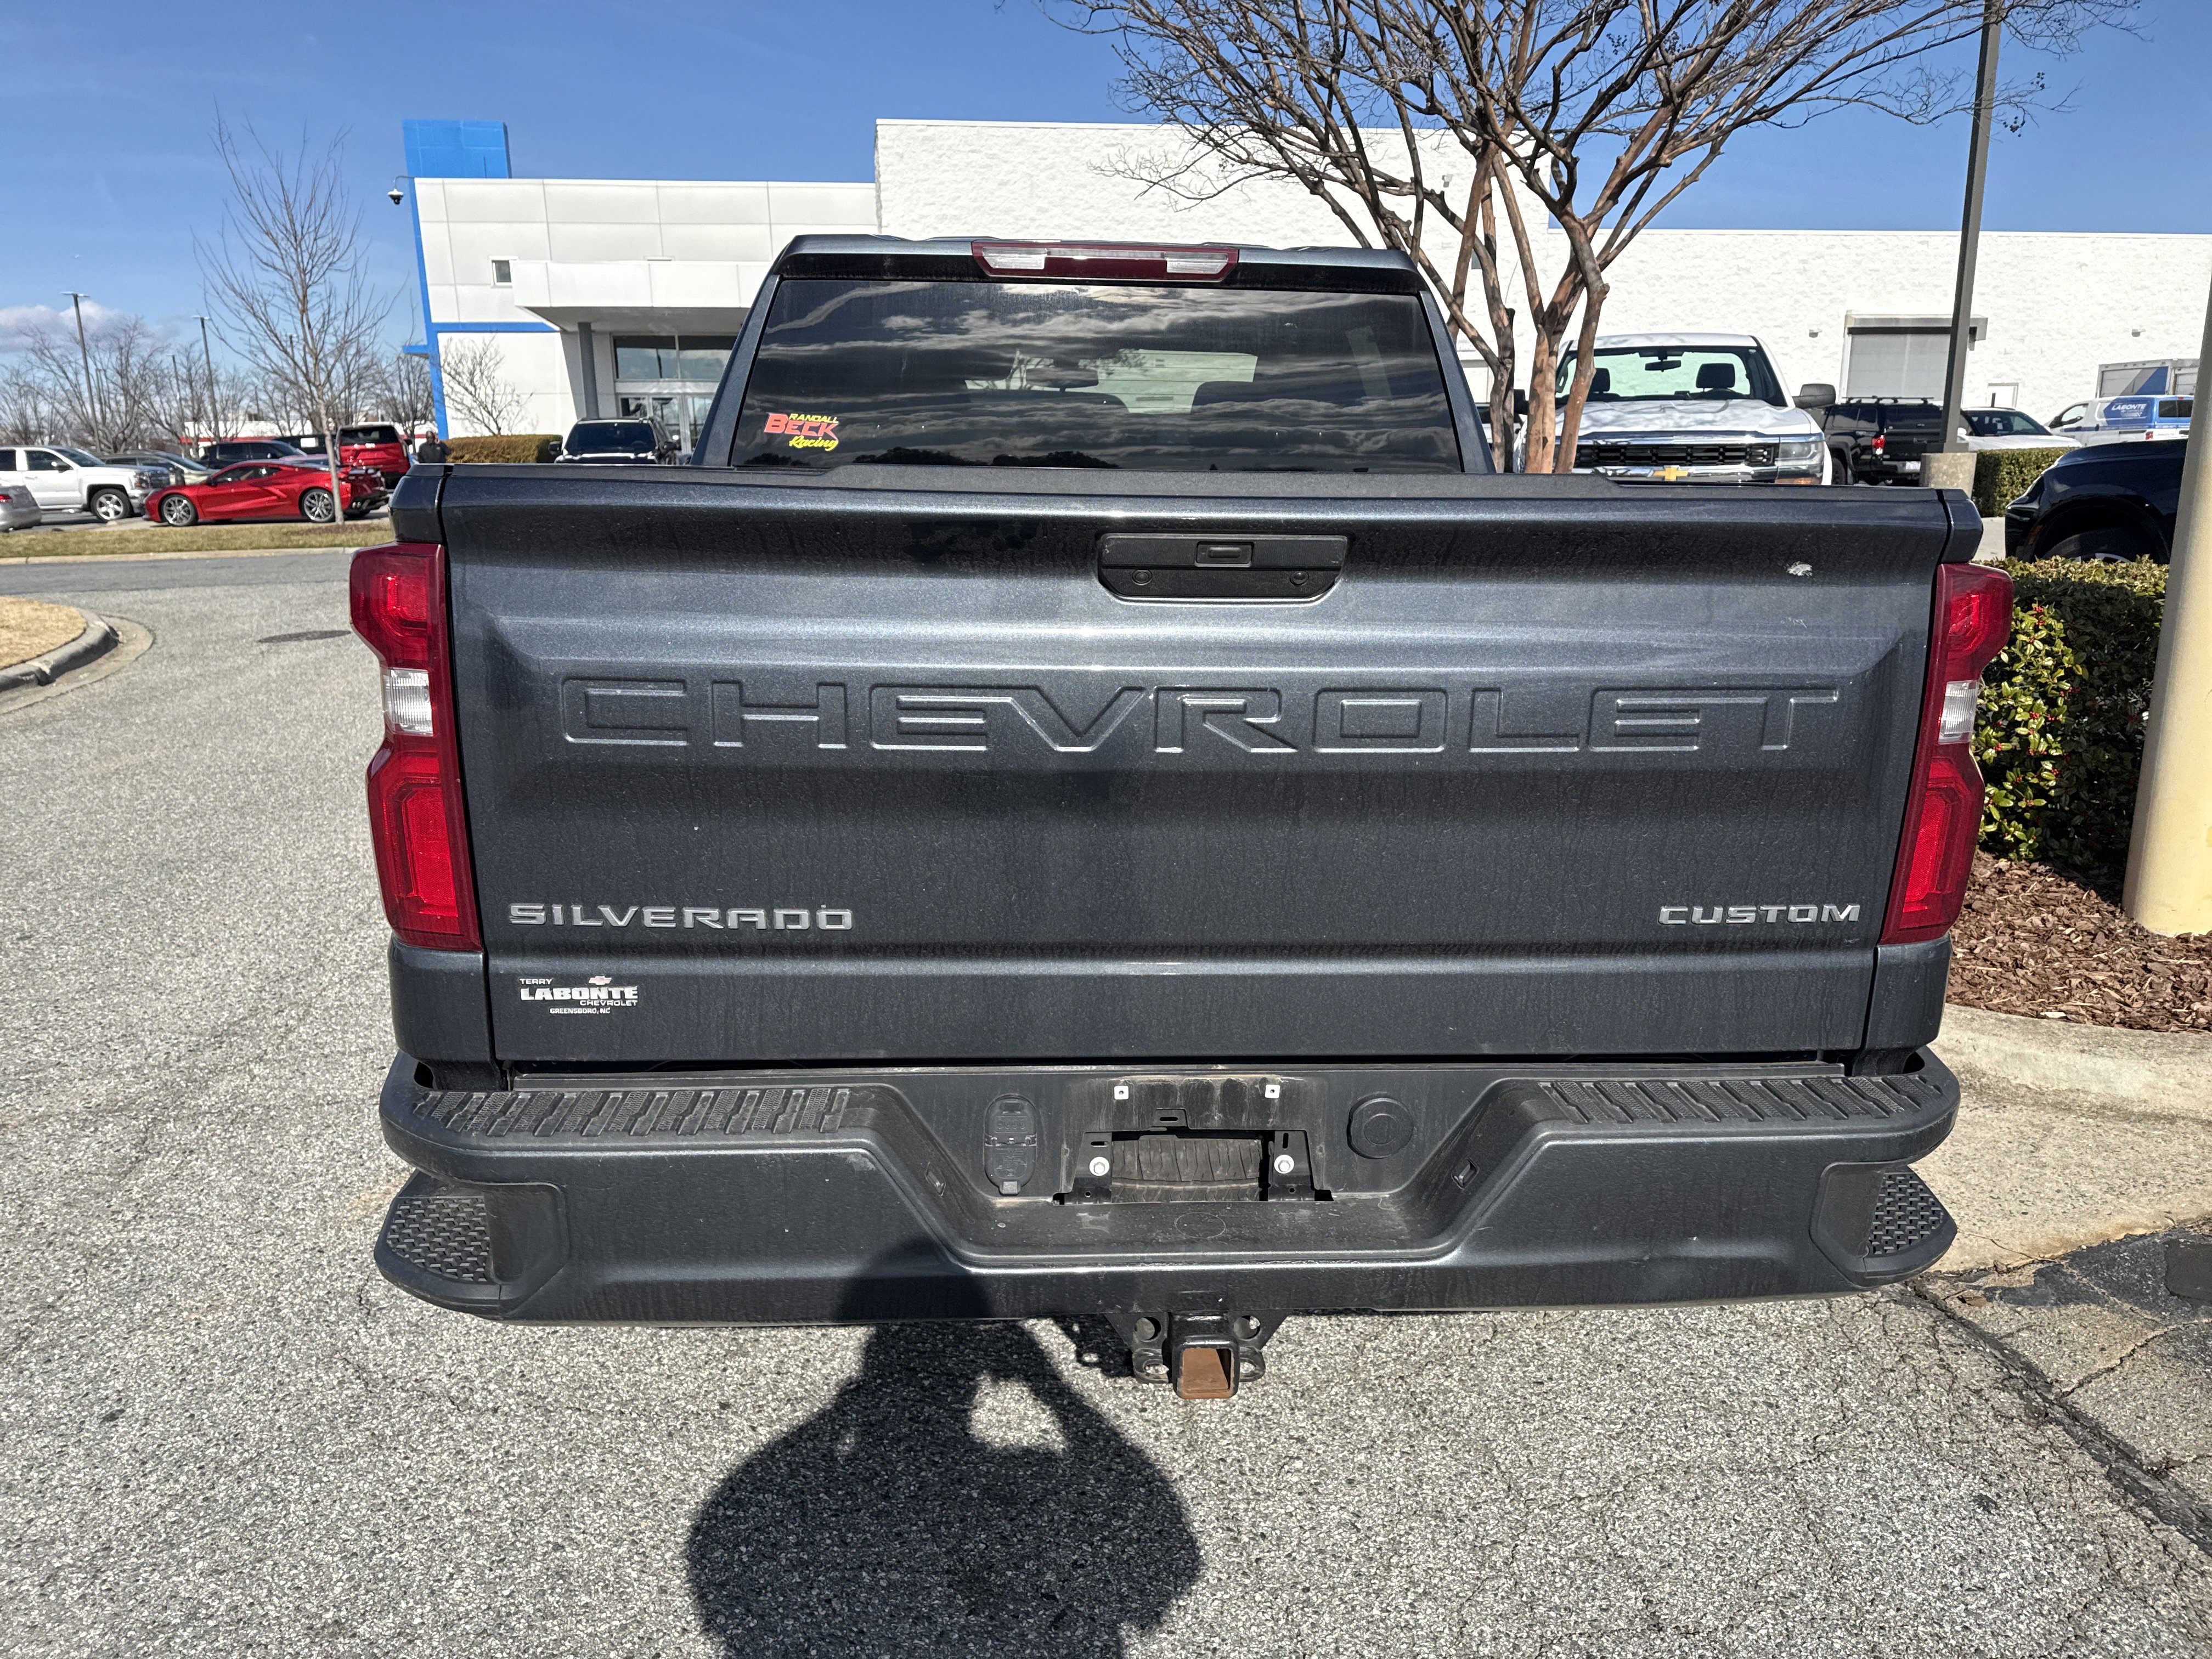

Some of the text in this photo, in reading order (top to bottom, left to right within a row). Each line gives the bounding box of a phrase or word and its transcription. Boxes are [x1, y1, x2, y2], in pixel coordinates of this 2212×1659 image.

[764, 413, 839, 441] BECK
[788, 413, 839, 424] RANDALL
[789, 435, 839, 452] Racing
[561, 677, 1839, 754] CHEVROLET
[509, 904, 853, 930] SILVERADO
[1657, 904, 1860, 924] CUSTOM
[520, 987, 638, 1000] LABONTE
